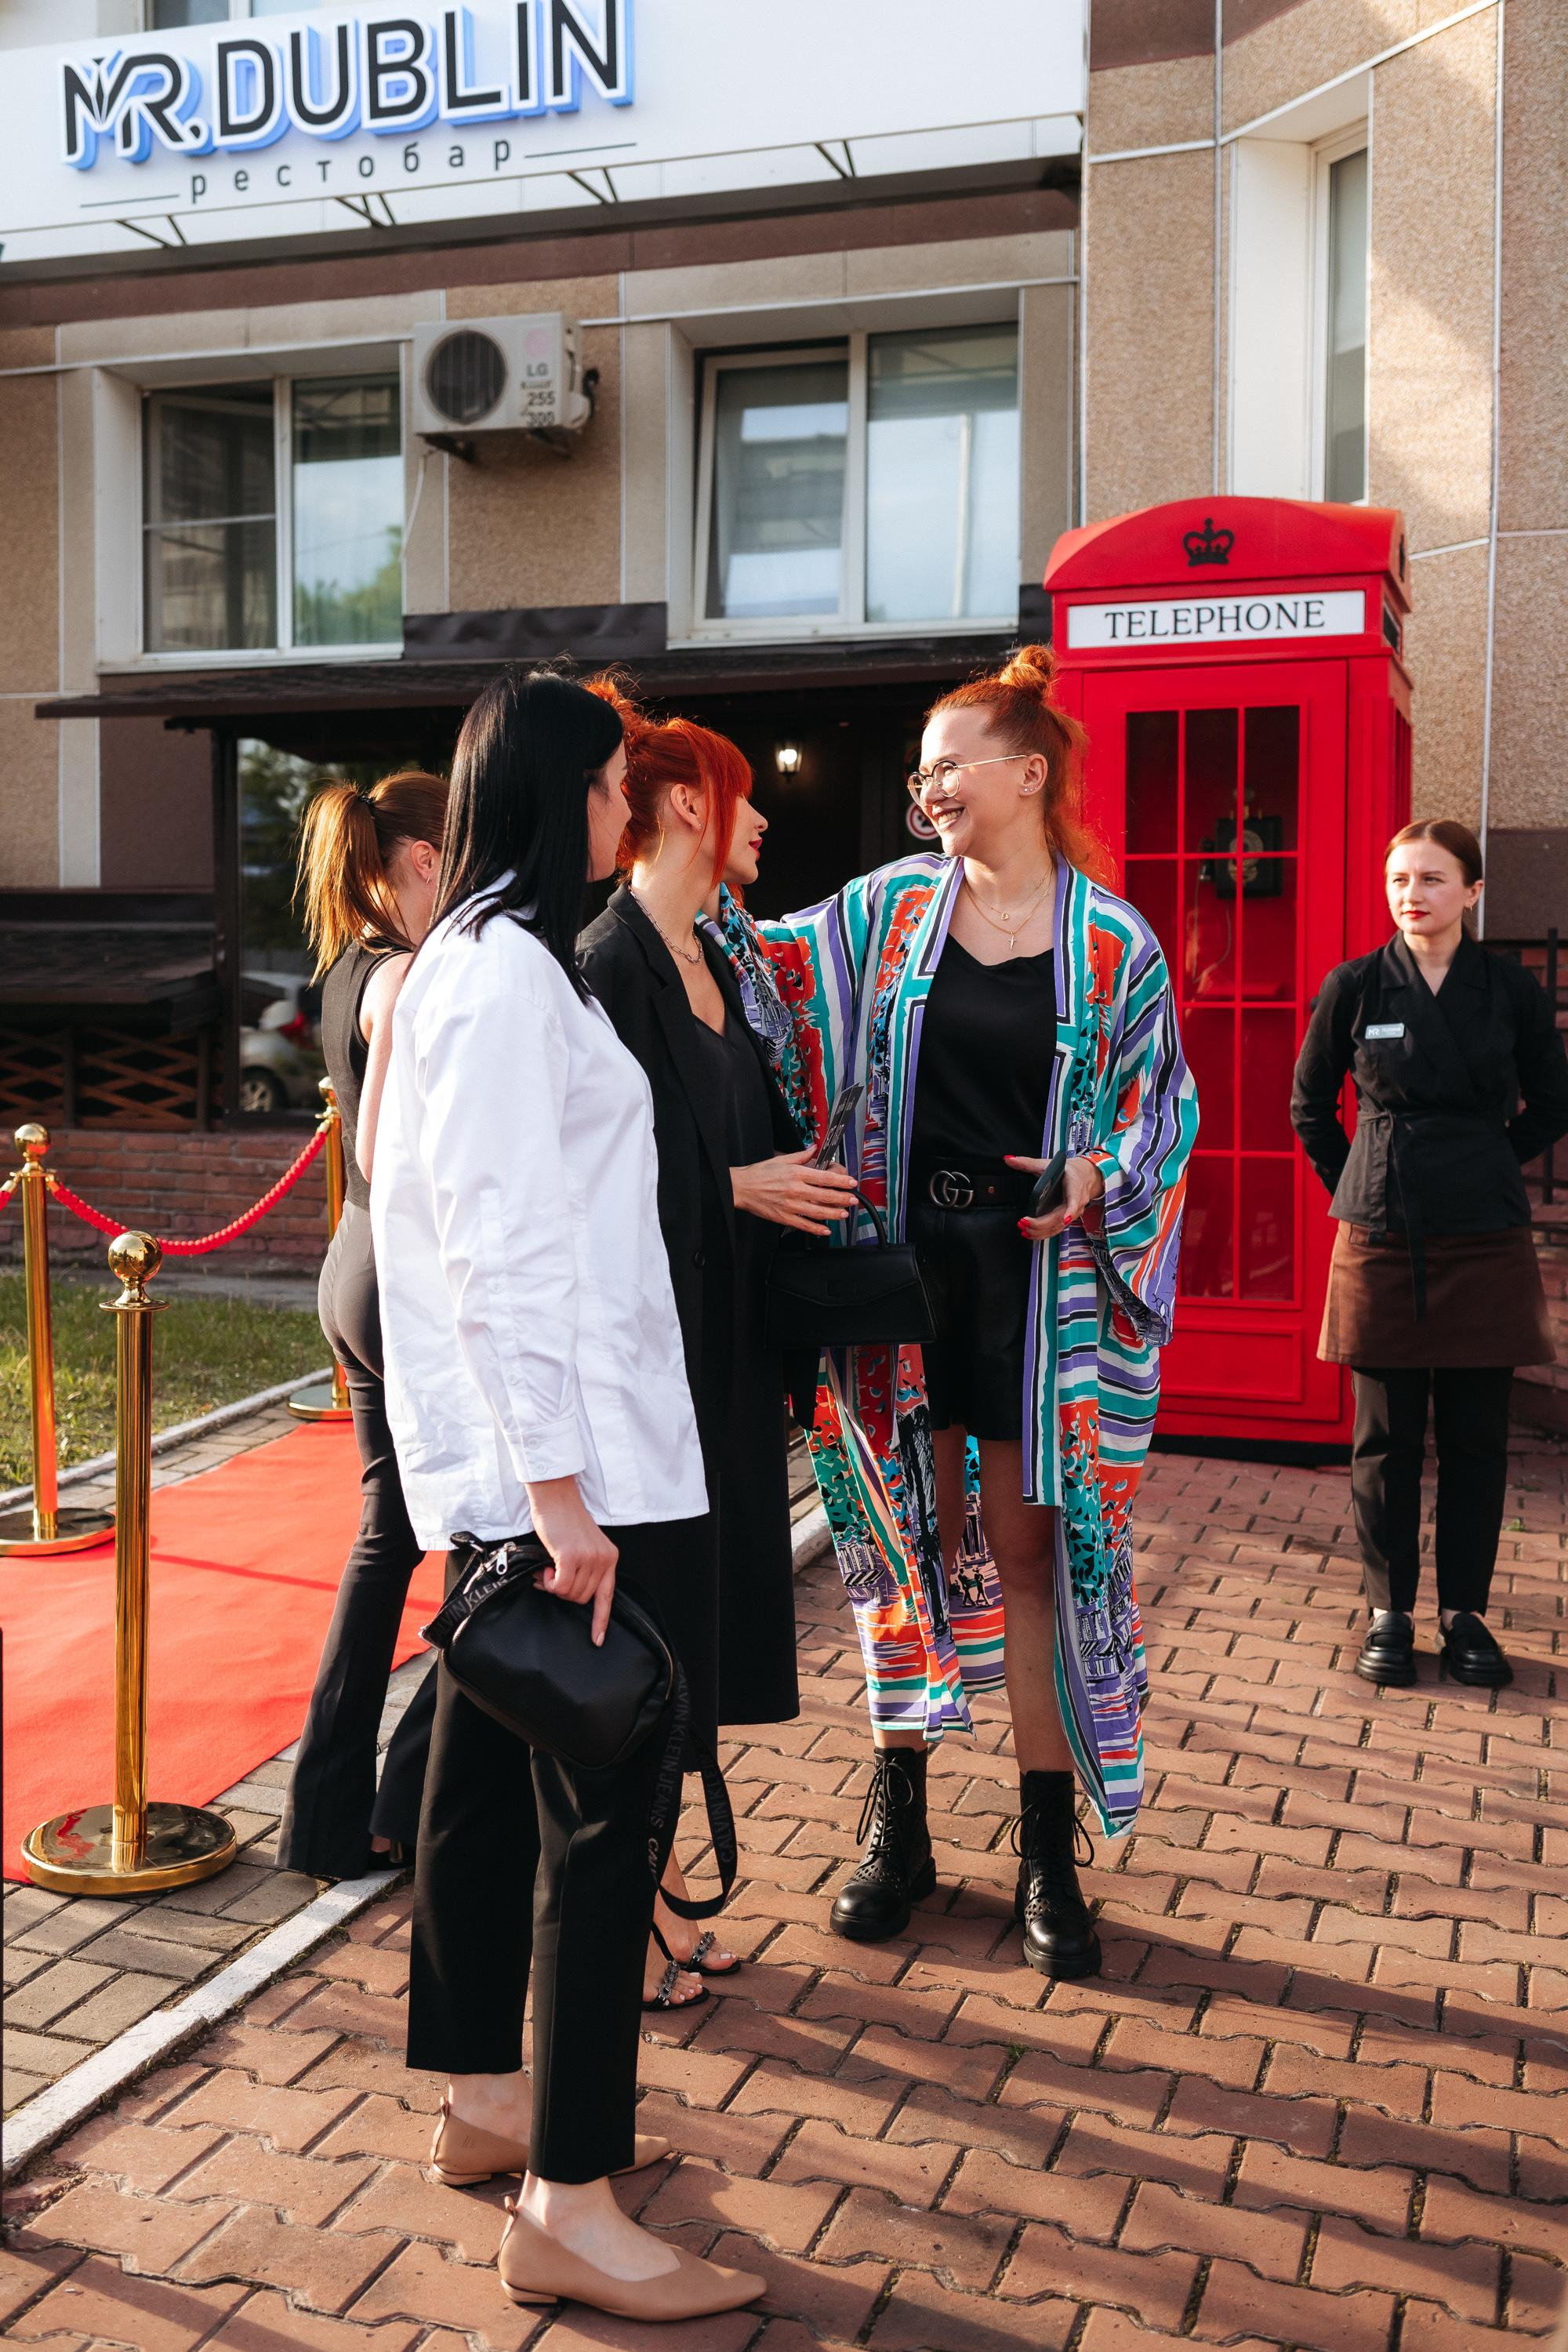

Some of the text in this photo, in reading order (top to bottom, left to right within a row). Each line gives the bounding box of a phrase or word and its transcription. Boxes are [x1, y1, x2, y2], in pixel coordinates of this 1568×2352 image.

[191, 140, 512, 205] рестобар
[527, 363, 549, 377] LG
[1104, 599, 1326, 639] TELEPHONE
[650, 1773, 675, 1828] JEANS
